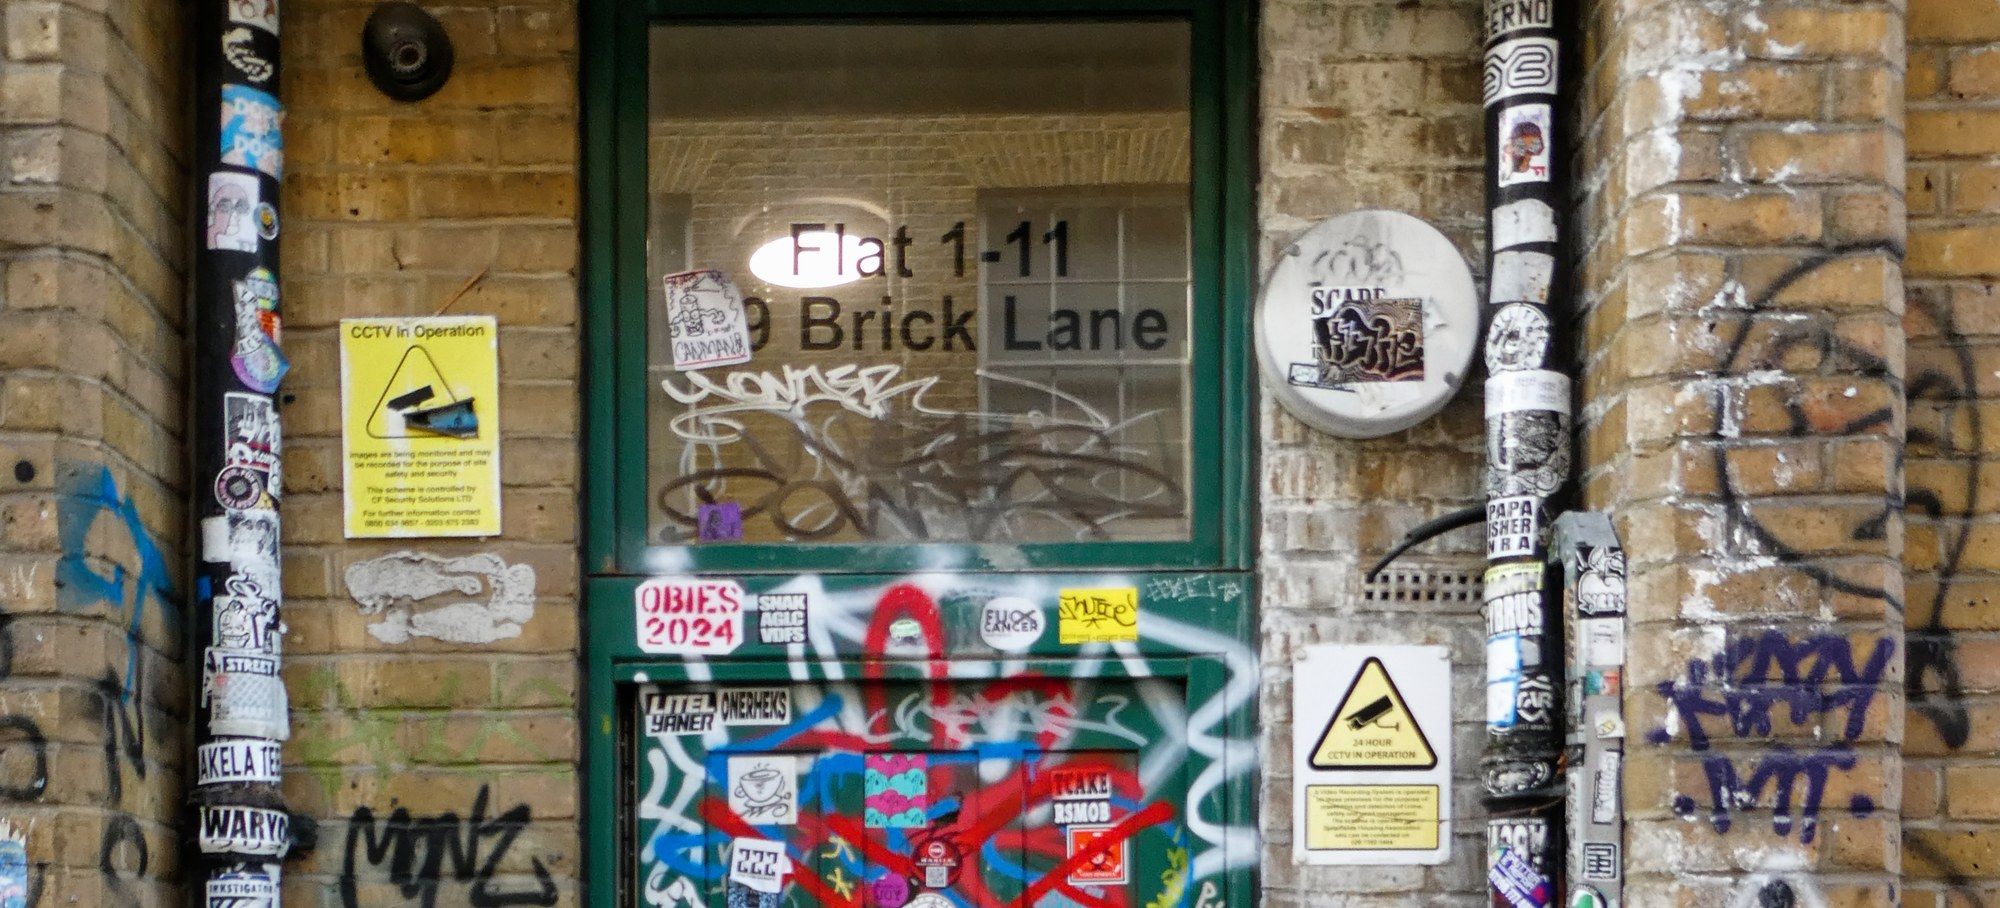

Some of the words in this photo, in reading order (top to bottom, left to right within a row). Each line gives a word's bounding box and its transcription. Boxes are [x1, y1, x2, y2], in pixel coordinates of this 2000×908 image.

[790, 223, 912, 277] Flat
[942, 221, 1068, 277] 1-11
[351, 326, 392, 338] CCTV
[397, 327, 409, 337] In
[414, 325, 485, 340] Operation
[800, 296, 977, 351] Brick
[1005, 295, 1168, 351] Lane
[466, 485, 476, 494] by
[384, 496, 416, 505] Security
[641, 585, 740, 614] OBIES
[645, 617, 735, 646] 2024
[984, 623, 1038, 632] CANCER
[226, 657, 274, 676] STREET
[1328, 752, 1351, 760] CCTV
[1054, 801, 1111, 823] RSMOB
